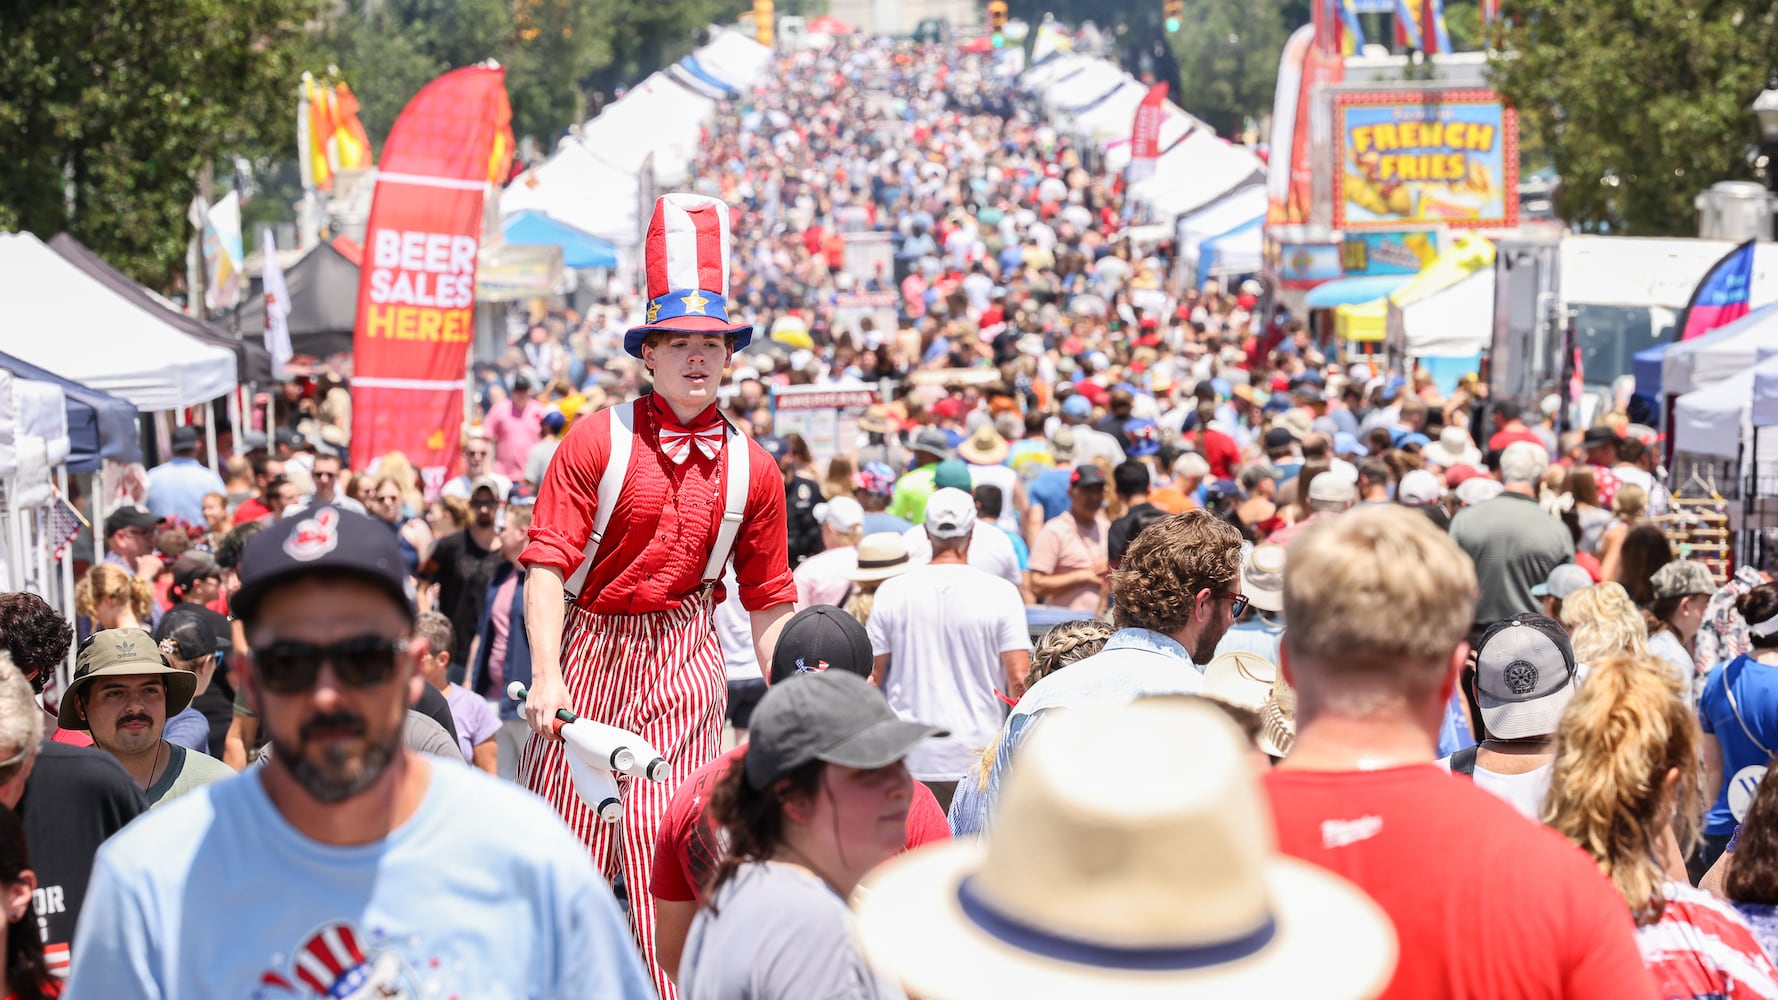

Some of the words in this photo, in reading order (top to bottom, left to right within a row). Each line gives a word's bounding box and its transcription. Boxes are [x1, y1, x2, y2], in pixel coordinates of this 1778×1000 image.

[1351, 121, 1496, 153] FRENCH
[1379, 153, 1467, 182] FRIES
[374, 229, 478, 275] BEER
[369, 268, 474, 308] SALES
[366, 303, 472, 342] HERE!
